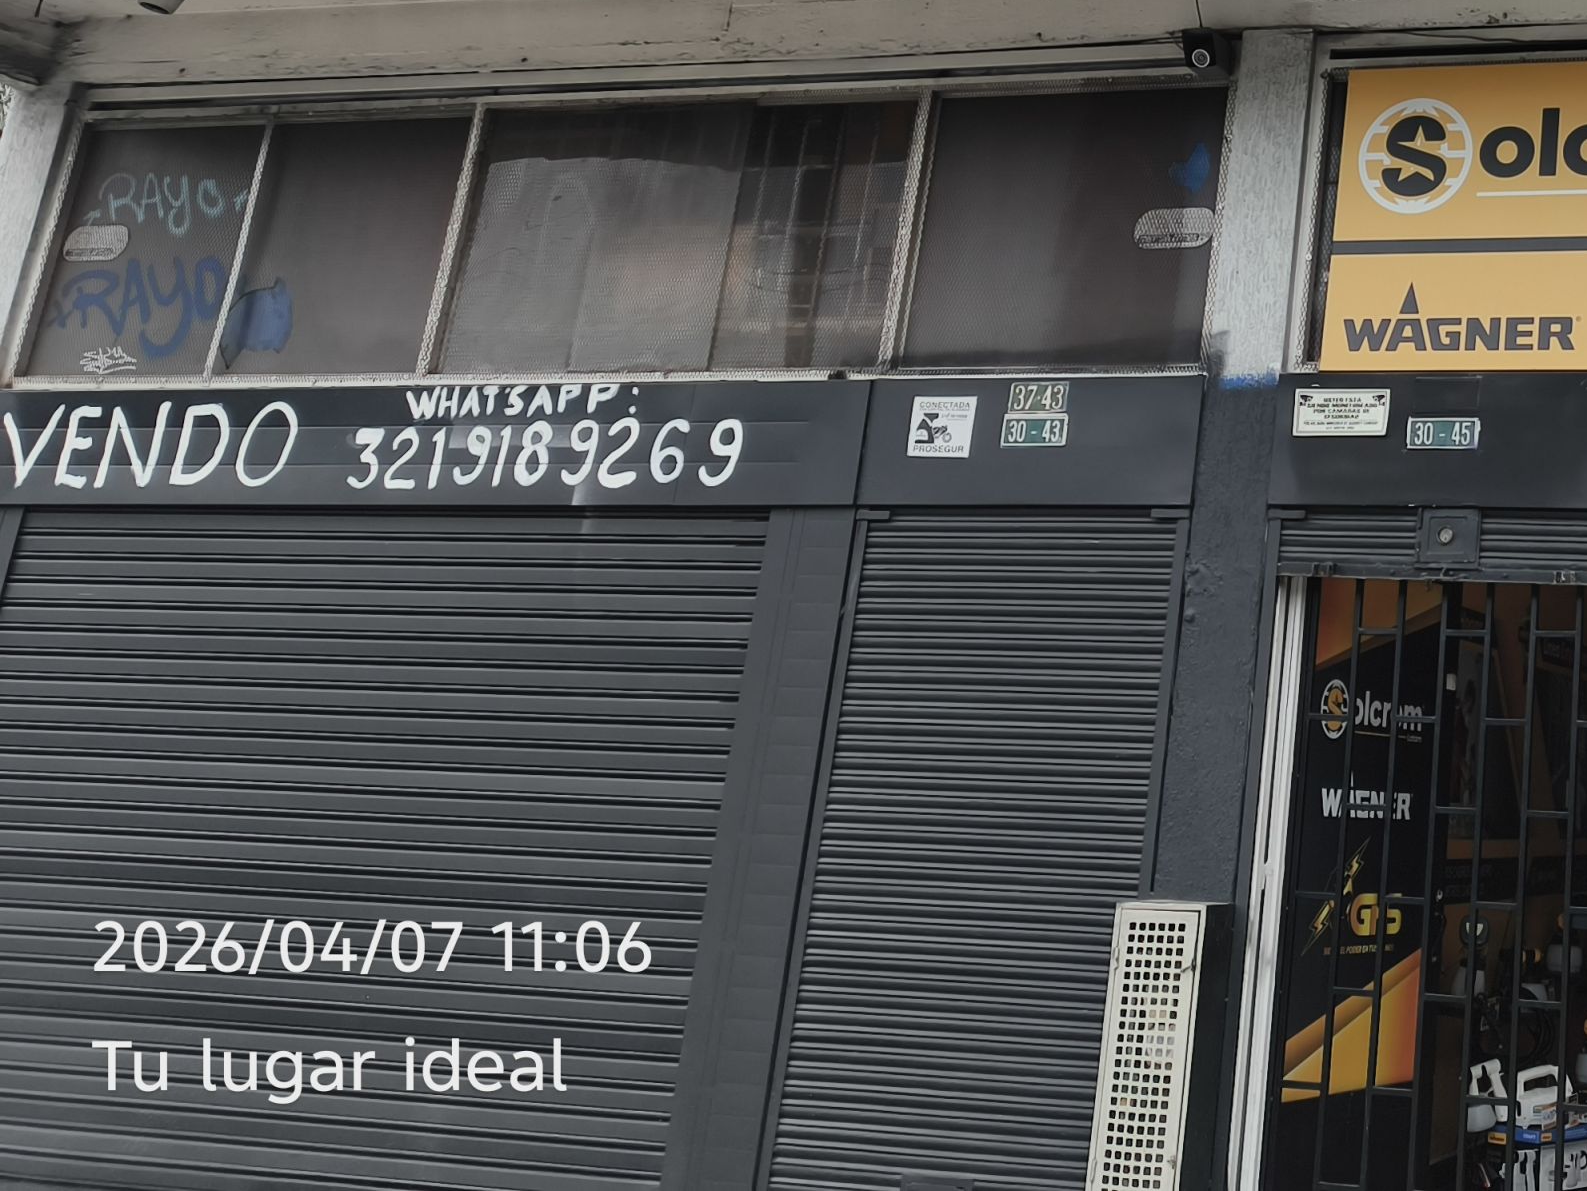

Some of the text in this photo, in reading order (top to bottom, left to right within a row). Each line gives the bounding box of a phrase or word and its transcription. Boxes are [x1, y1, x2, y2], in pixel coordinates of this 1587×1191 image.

[99, 173, 225, 237] RAYO
[62, 256, 226, 359] RAYO
[1343, 283, 1575, 352] WAGNER
[4, 401, 298, 489] VENDO
[1328, 688, 1423, 732] Solcrm
